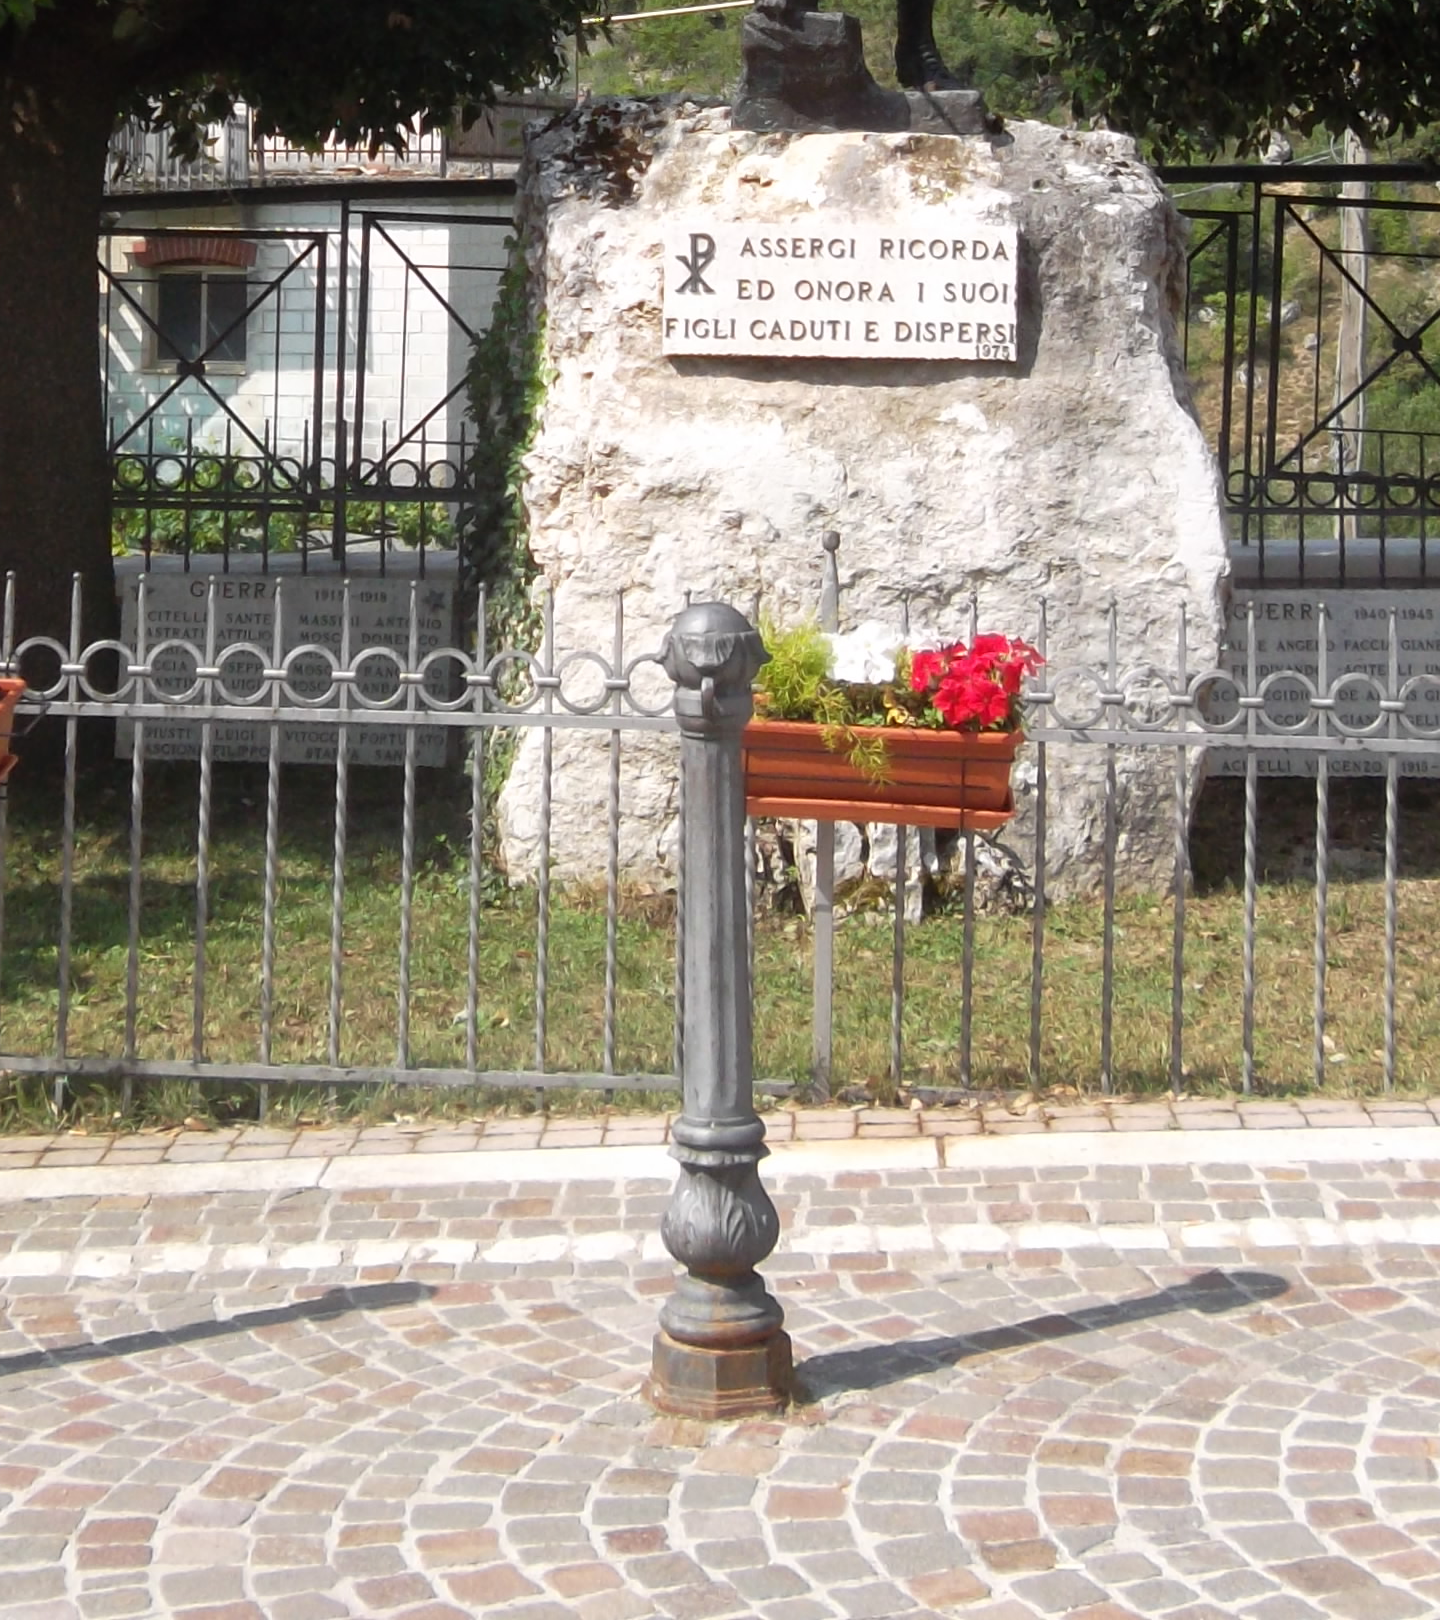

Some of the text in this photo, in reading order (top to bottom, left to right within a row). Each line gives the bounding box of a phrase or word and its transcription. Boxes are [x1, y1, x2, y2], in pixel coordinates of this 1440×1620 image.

[739, 237, 1010, 262] ASSERGI RICORDA
[737, 279, 1009, 304] ED ONORA I SUOI
[665, 318, 1015, 344] FIGLI CADUTI E DISPERSI
[975, 344, 1010, 360] 1975
[190, 581, 282, 600] GERR
[226, 613, 272, 626] SANTE
[133, 627, 272, 641] ASTRATI ATTILIO
[299, 631, 438, 646] MOSC DOMENCO
[1344, 639, 1392, 652] FACCI
[293, 663, 335, 677] MOSC
[1232, 664, 1322, 678] FEDINAND
[1344, 663, 1412, 677] ACITELI
[215, 729, 255, 741] LUIGI
[286, 730, 444, 746] VITOCC FORTUATO
[131, 743, 202, 756] ASCIONI
[1222, 760, 1291, 772] ACIELLI
